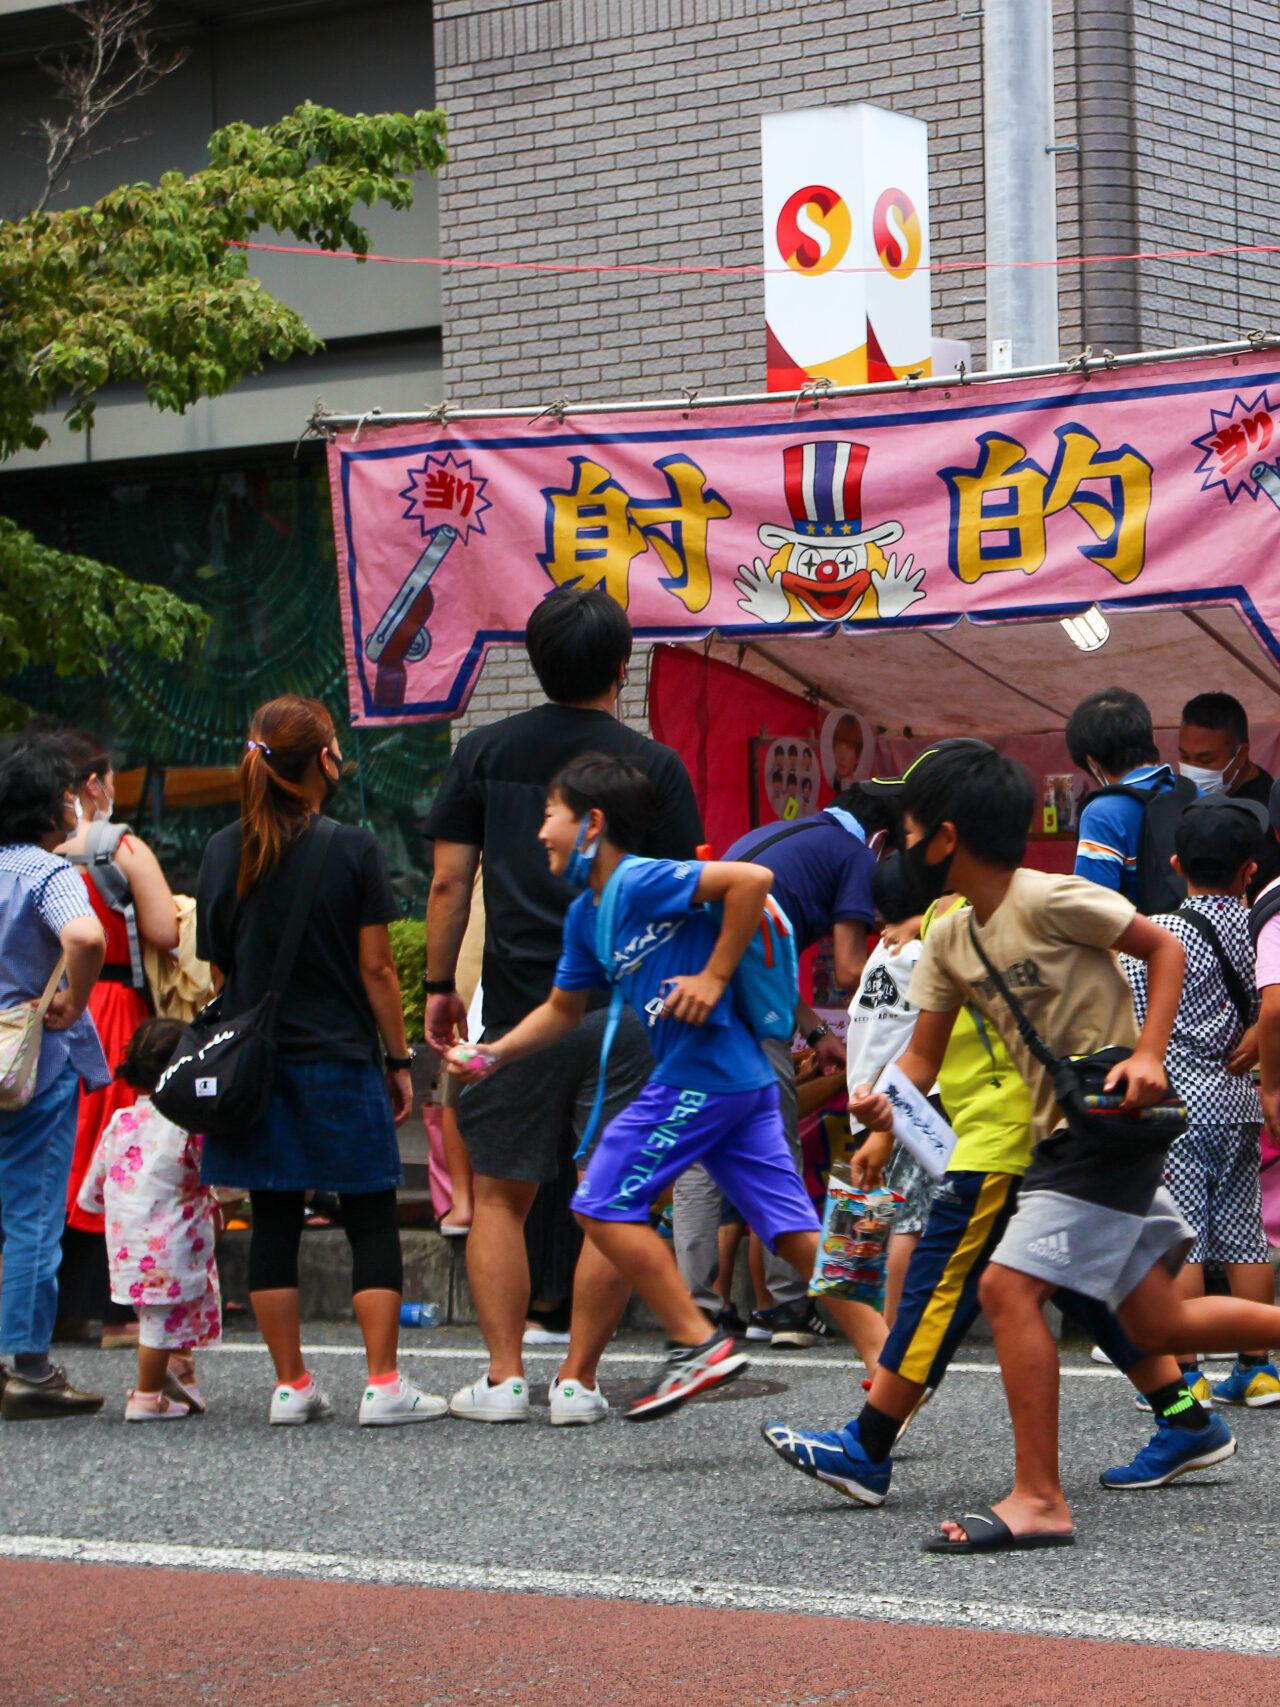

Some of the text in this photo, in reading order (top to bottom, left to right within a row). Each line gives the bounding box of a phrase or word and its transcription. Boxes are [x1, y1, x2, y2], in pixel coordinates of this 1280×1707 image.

[1210, 411, 1274, 475] 当り
[422, 469, 475, 518] 当り
[608, 1089, 707, 1211] BENETTON
